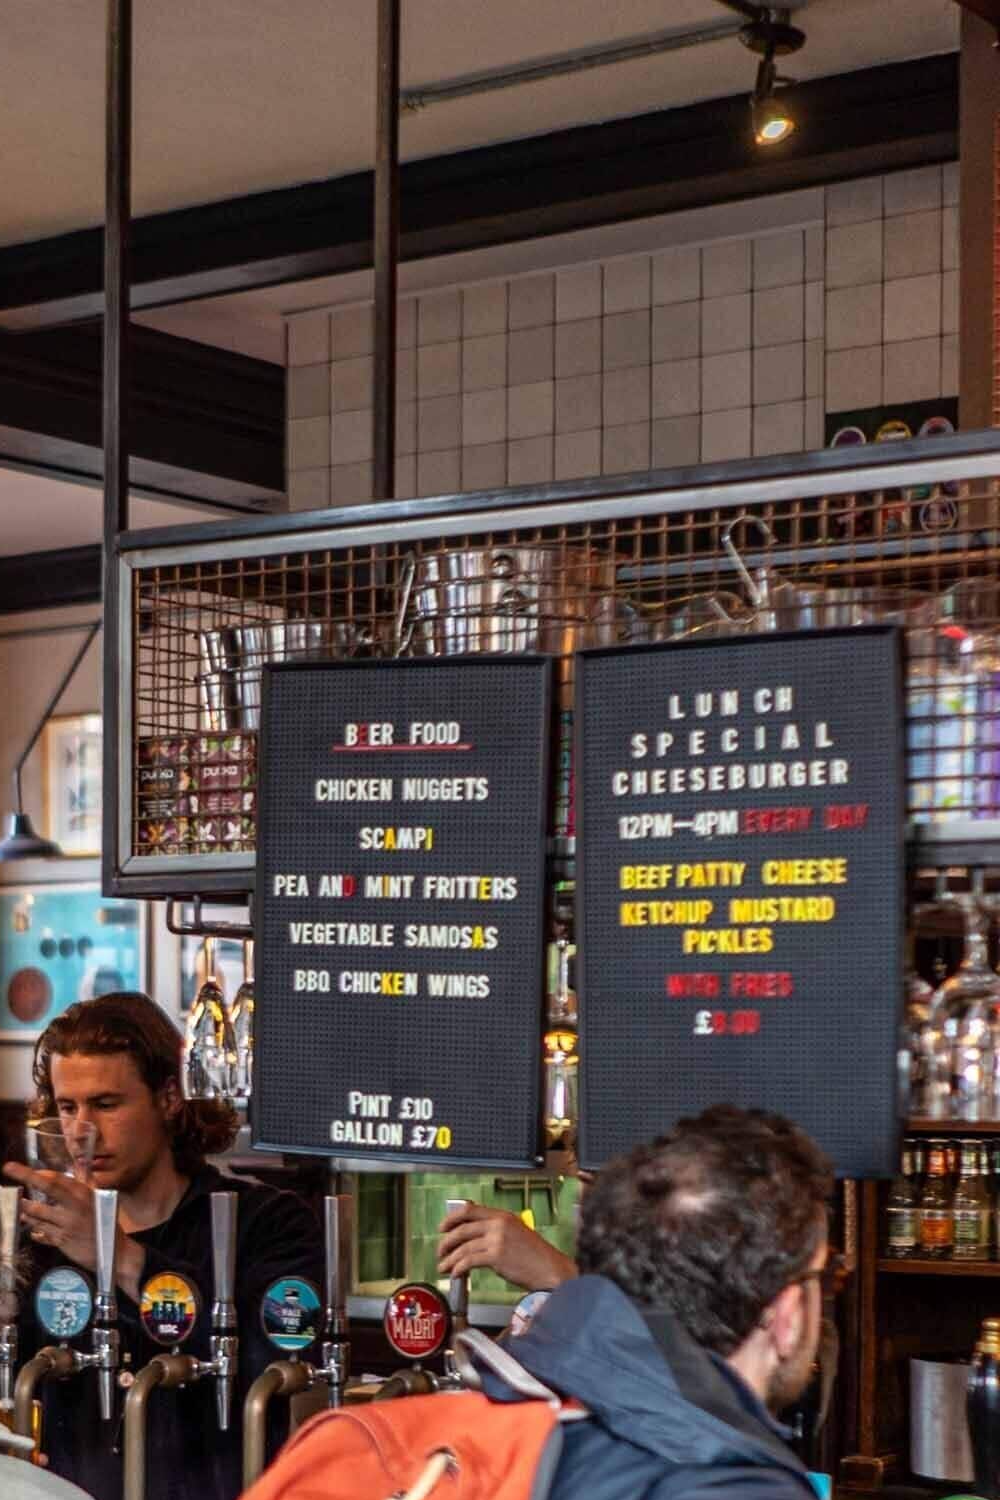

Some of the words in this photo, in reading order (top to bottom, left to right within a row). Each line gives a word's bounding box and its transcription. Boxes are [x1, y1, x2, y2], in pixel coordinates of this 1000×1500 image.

[668, 686, 793, 720] LUNCH
[345, 723, 394, 745] BEER
[410, 722, 460, 744] FOOD
[631, 722, 833, 759] SPECIAL
[315, 779, 393, 801] CHICKEN
[402, 778, 489, 801] NUGGETS
[612, 759, 849, 796] CHEESEBURGER
[743, 806, 813, 835] EVERY
[359, 827, 433, 849] SCAMPI
[274, 874, 309, 897] PEA
[319, 875, 356, 897] AND
[365, 875, 414, 898] MINT
[424, 876, 518, 900] FRITTERS
[620, 864, 672, 890] BEEF
[675, 861, 746, 888] PATTY
[761, 858, 848, 885] CHEESE
[620, 900, 714, 926] KETCHUP
[729, 896, 835, 923] MUSTARD
[290, 922, 394, 947] VEGETABLE
[404, 924, 498, 950] SAMOSAS
[682, 928, 774, 954] PICKLES
[294, 970, 330, 993] BBQ
[339, 971, 418, 995] CHICKEN
[427, 974, 490, 998] WINGS
[349, 1091, 392, 1118] PINT
[400, 1097, 433, 1120] £10
[330, 1120, 402, 1146] GALLON
[409, 1126, 452, 1149] £70
